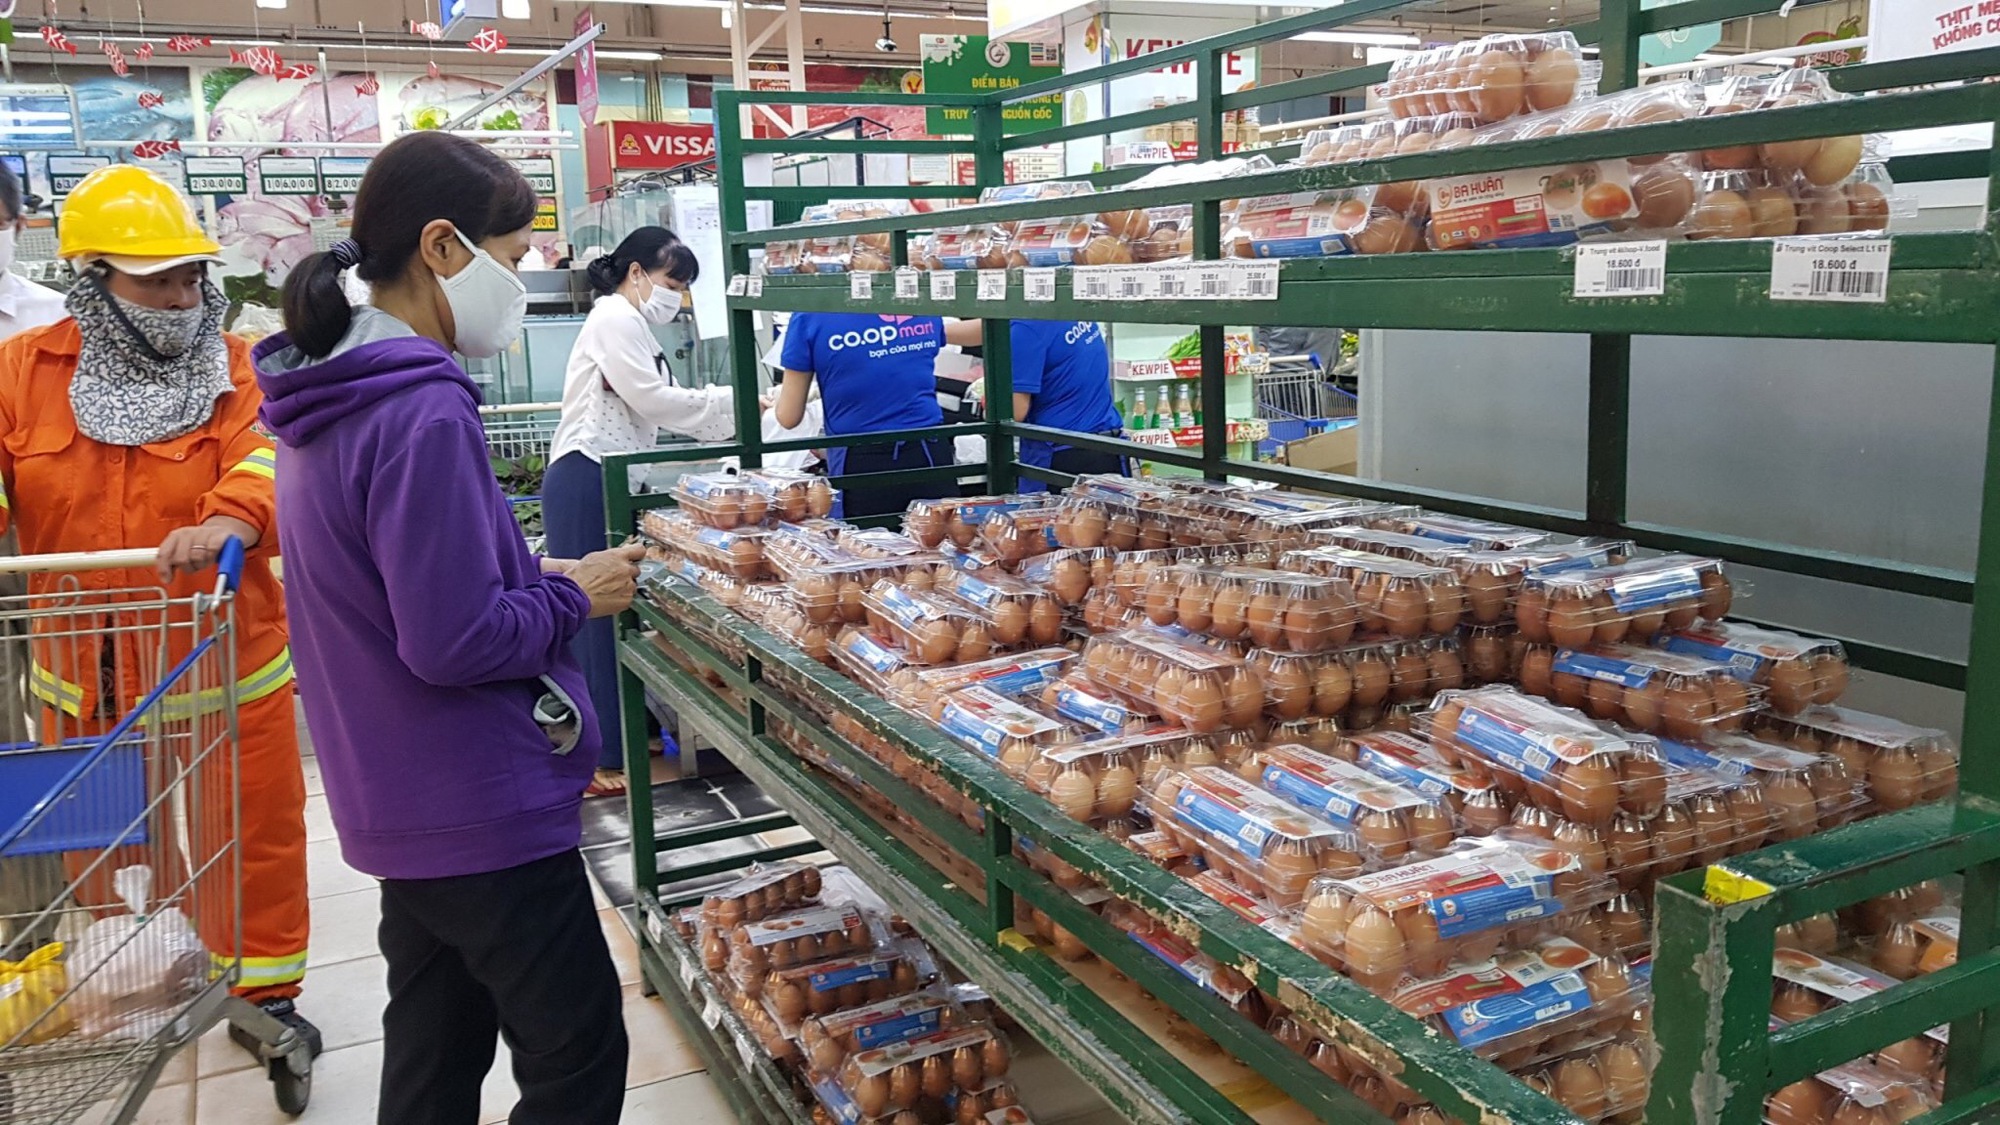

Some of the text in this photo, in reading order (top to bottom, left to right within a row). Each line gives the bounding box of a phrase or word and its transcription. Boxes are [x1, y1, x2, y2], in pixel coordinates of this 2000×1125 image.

[1932, 22, 1982, 49] KHÔNG
[1000, 75, 1020, 88] BÁN
[943, 109, 969, 119] TRUY
[1453, 184, 1470, 199] BA
[1471, 176, 1505, 197] HUÂN
[1818, 245, 1839, 254] Coop
[1840, 244, 1865, 252] Select
[1607, 259, 1633, 269] 18.600
[1812, 260, 1847, 270] 18.600
[869, 348, 888, 359] bạn
[889, 343, 908, 355] của
[908, 341, 923, 352] mọi
[1132, 363, 1169, 375] KEWPIE
